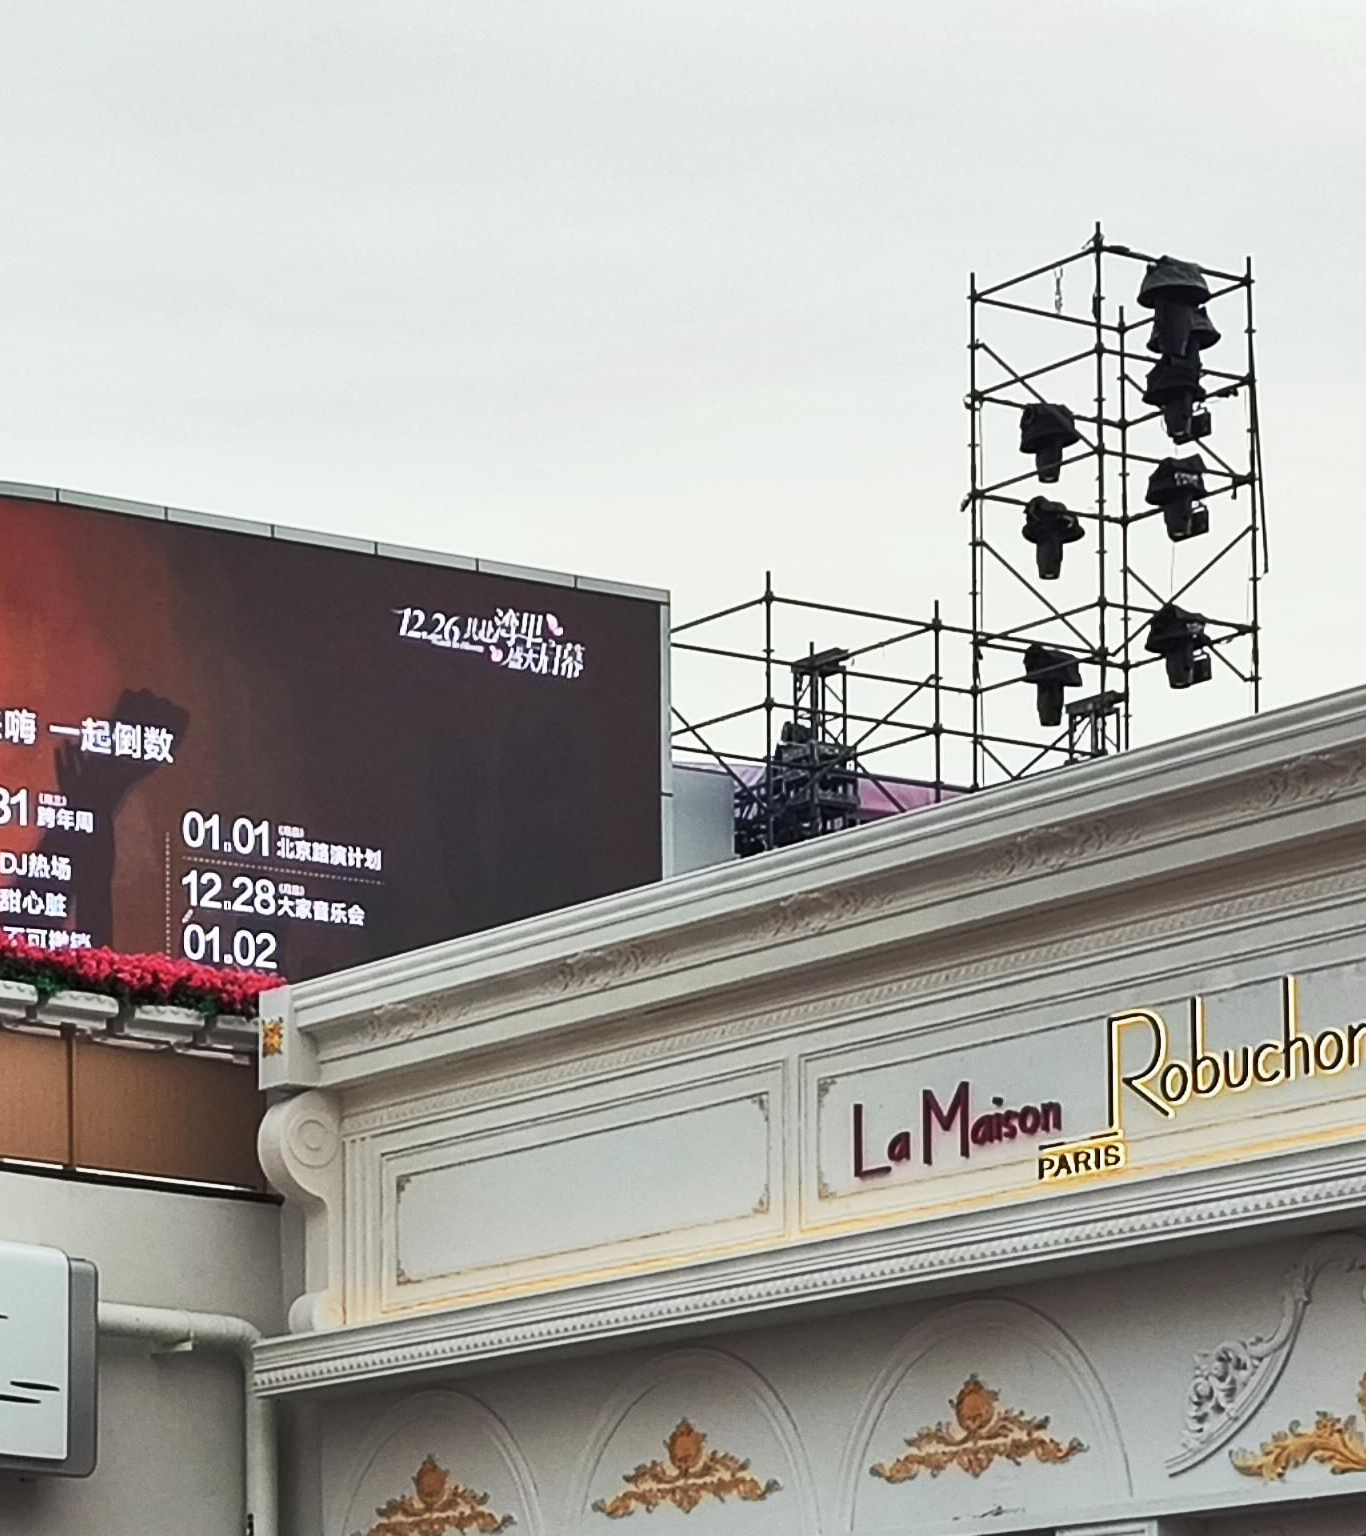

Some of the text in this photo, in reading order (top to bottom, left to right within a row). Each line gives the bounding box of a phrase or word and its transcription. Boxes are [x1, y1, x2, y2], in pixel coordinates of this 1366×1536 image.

[49, 718, 175, 763] 一起倒数
[36, 806, 94, 833] 跨年周
[182, 811, 270, 857] 01.01
[0, 851, 72, 880] DJ热场
[181, 869, 276, 916] 12.28
[183, 923, 278, 969] 01.02
[852, 1103, 912, 1178] La
[921, 1080, 1063, 1166] Maison
[1037, 1142, 1123, 1181] PARIS
